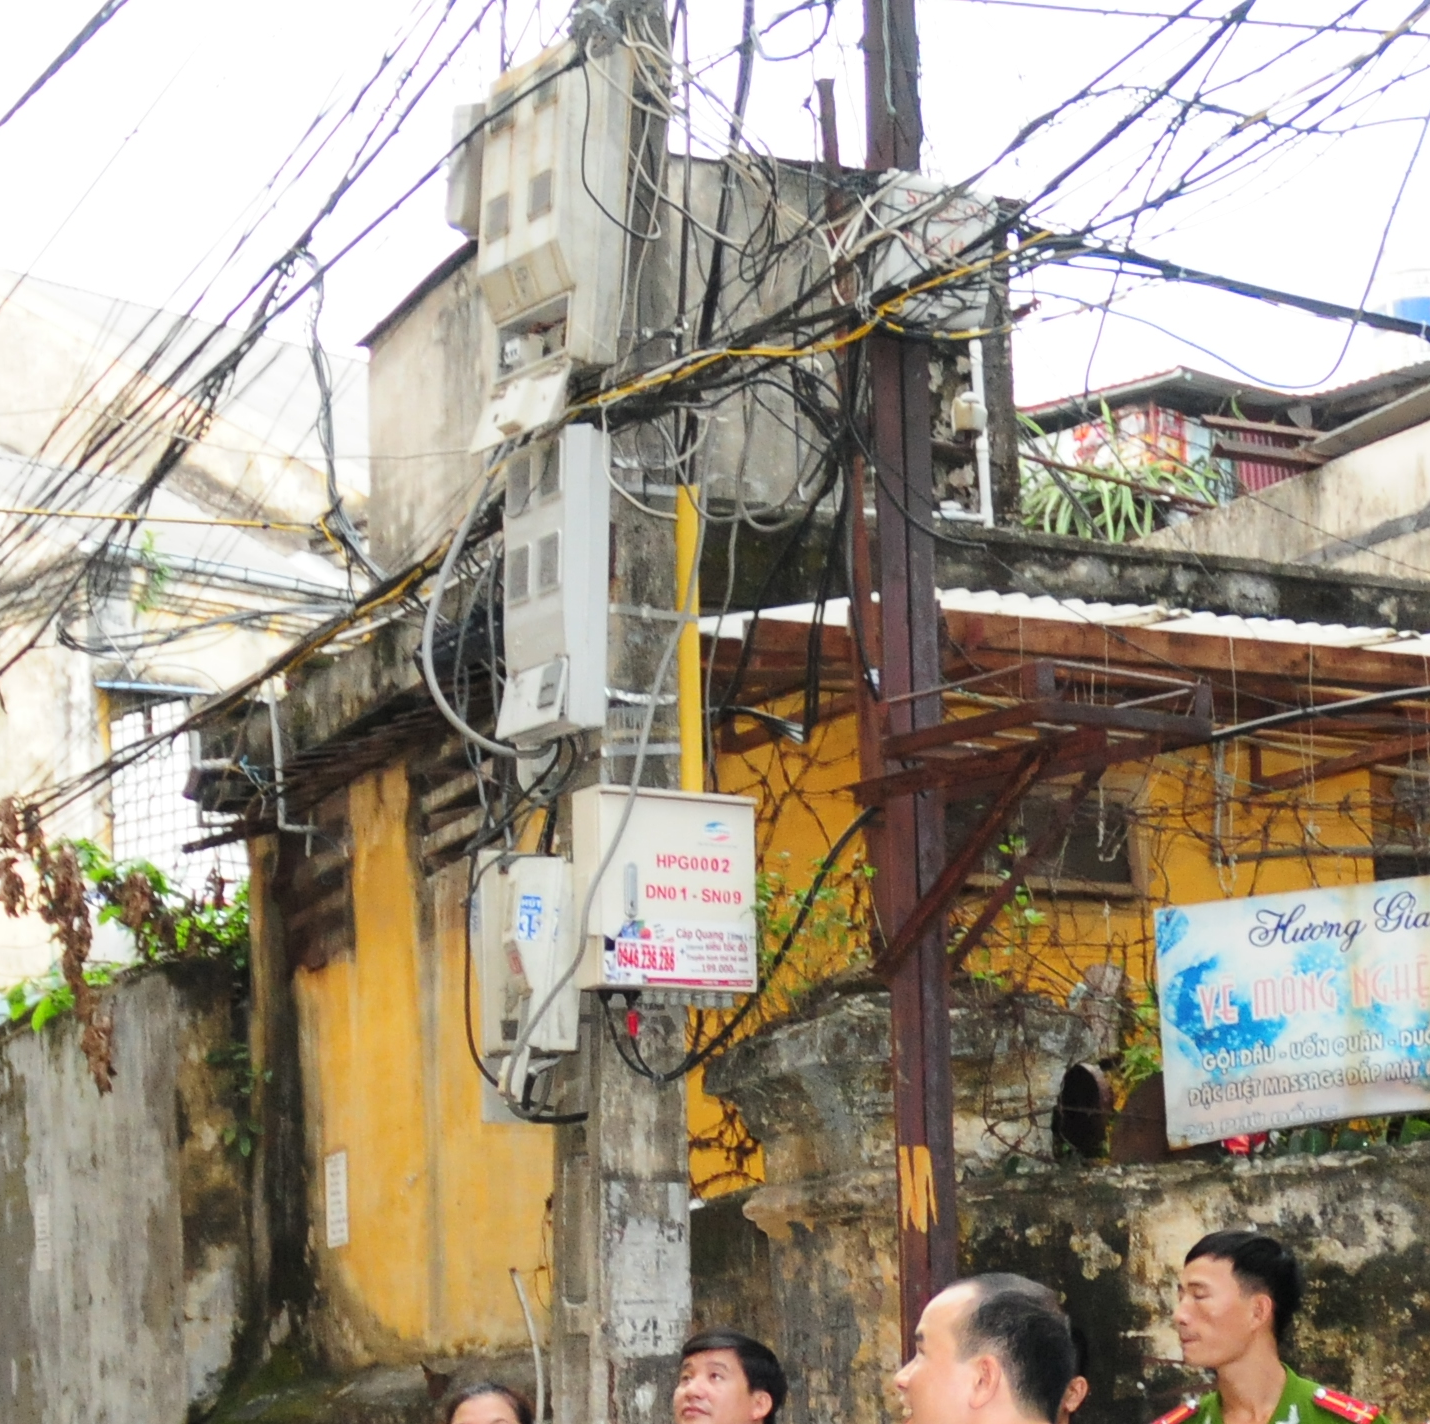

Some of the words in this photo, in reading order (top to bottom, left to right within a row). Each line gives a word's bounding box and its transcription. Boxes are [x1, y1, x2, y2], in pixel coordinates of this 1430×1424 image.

[656, 853, 730, 873] HPG0002
[645, 884, 687, 901] DN01
[701, 888, 743, 905] SN09
[1248, 903, 1367, 952] Hương
[1352, 953, 1430, 1008] NGHỆ
[1290, 1032, 1329, 1060] UỐN
[1226, 1076, 1262, 1104] BIỆT
[1263, 1069, 1344, 1097] MASSAGE
